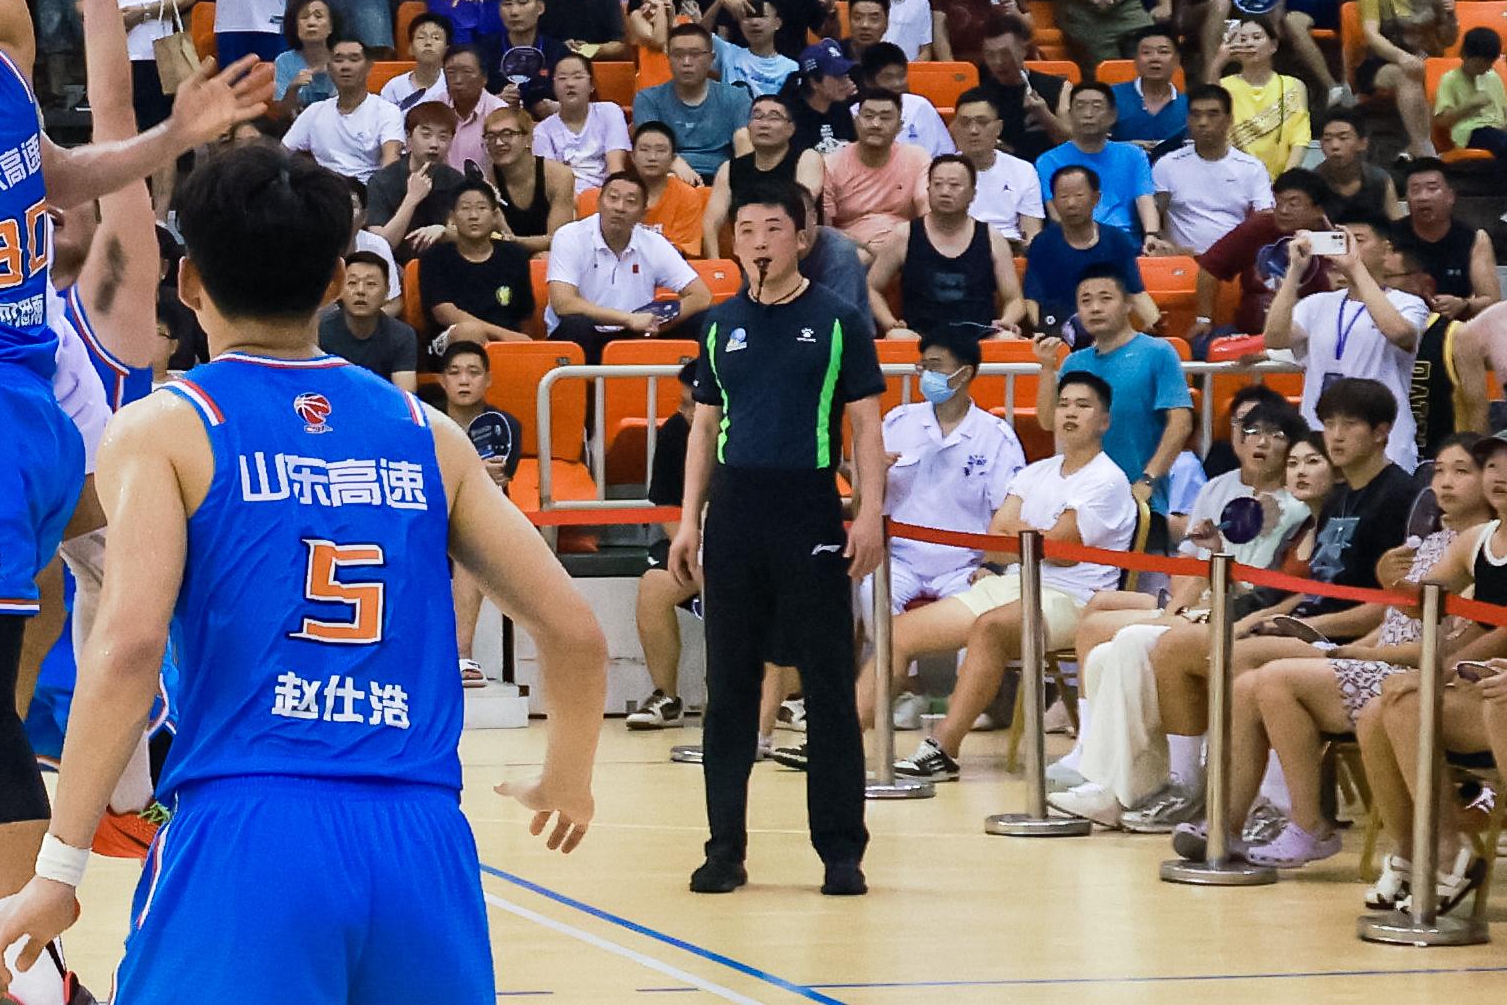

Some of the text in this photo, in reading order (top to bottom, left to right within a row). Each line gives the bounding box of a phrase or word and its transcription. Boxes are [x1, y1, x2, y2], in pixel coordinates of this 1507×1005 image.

[238, 450, 429, 511] 山东高速
[288, 538, 385, 645] 5
[271, 670, 411, 731] 赵仕浩
